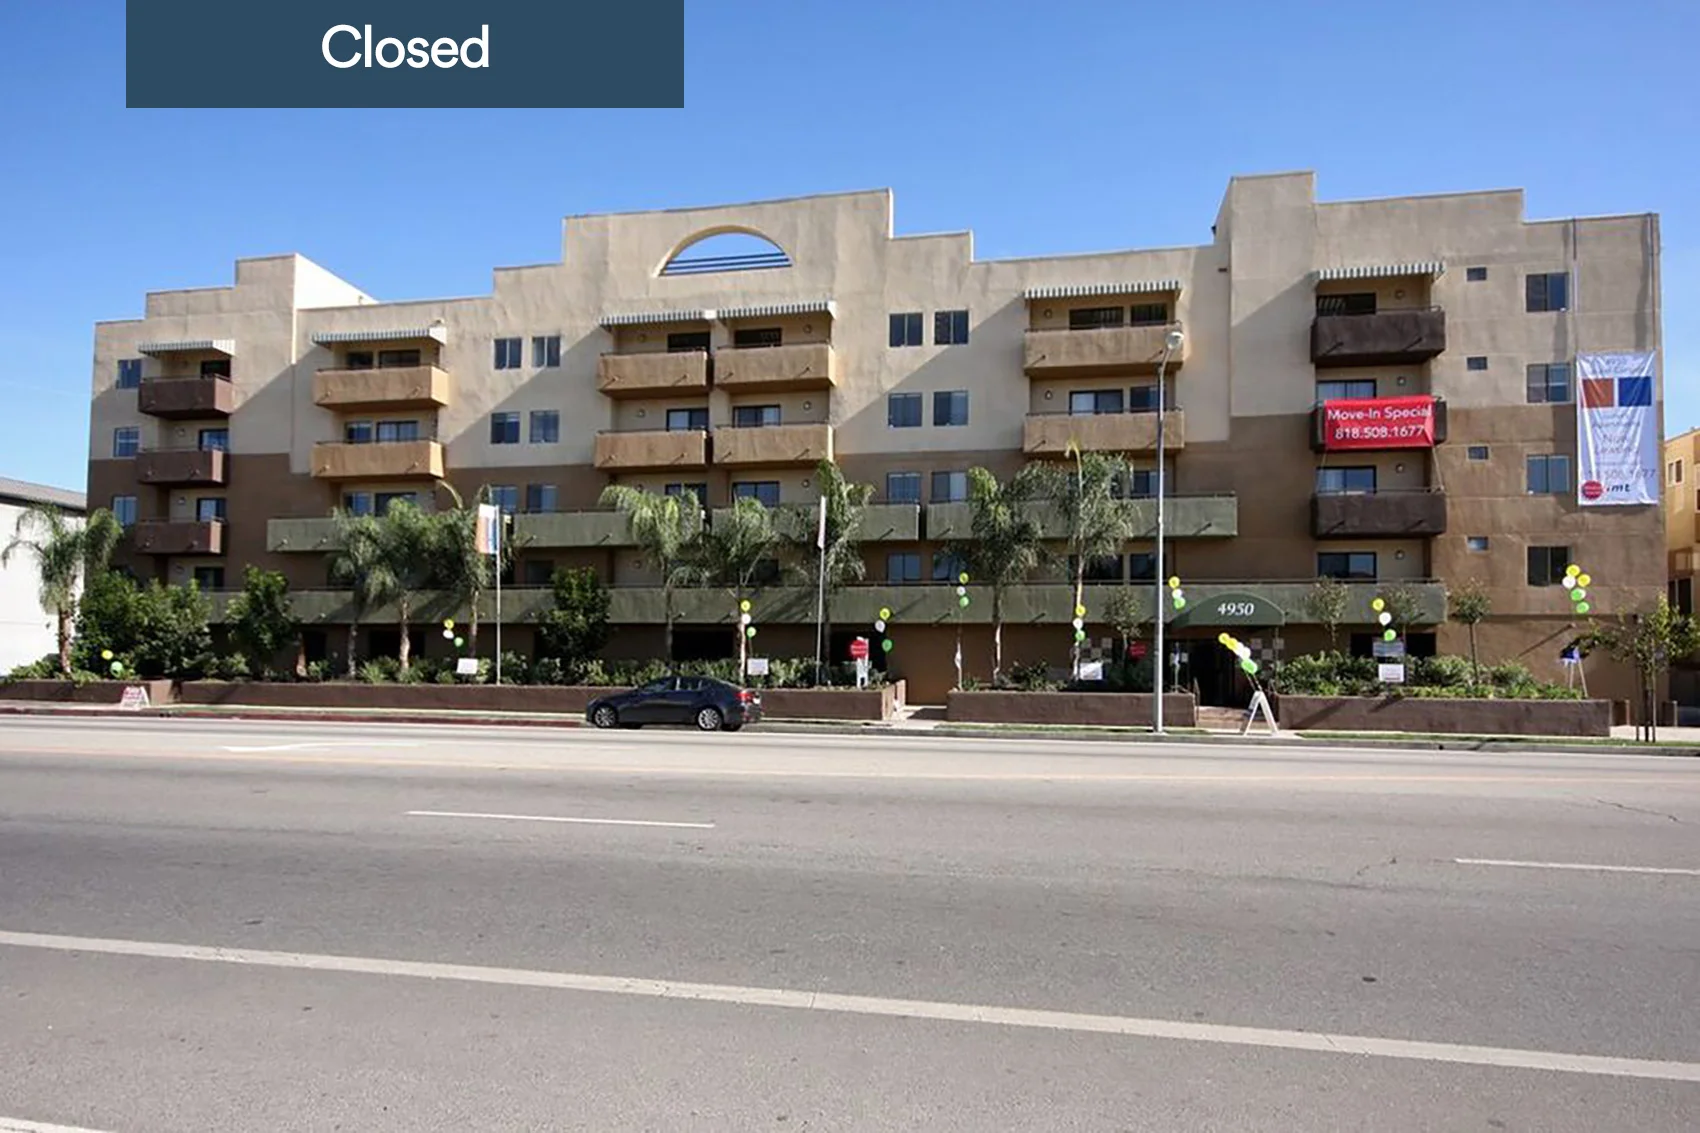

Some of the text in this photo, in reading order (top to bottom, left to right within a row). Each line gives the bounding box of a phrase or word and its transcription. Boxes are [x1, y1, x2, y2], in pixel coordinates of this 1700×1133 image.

[1328, 404, 1432, 420] Move-In Special
[1335, 425, 1425, 439] 818.508.1677
[1217, 602, 1255, 616] 4950
